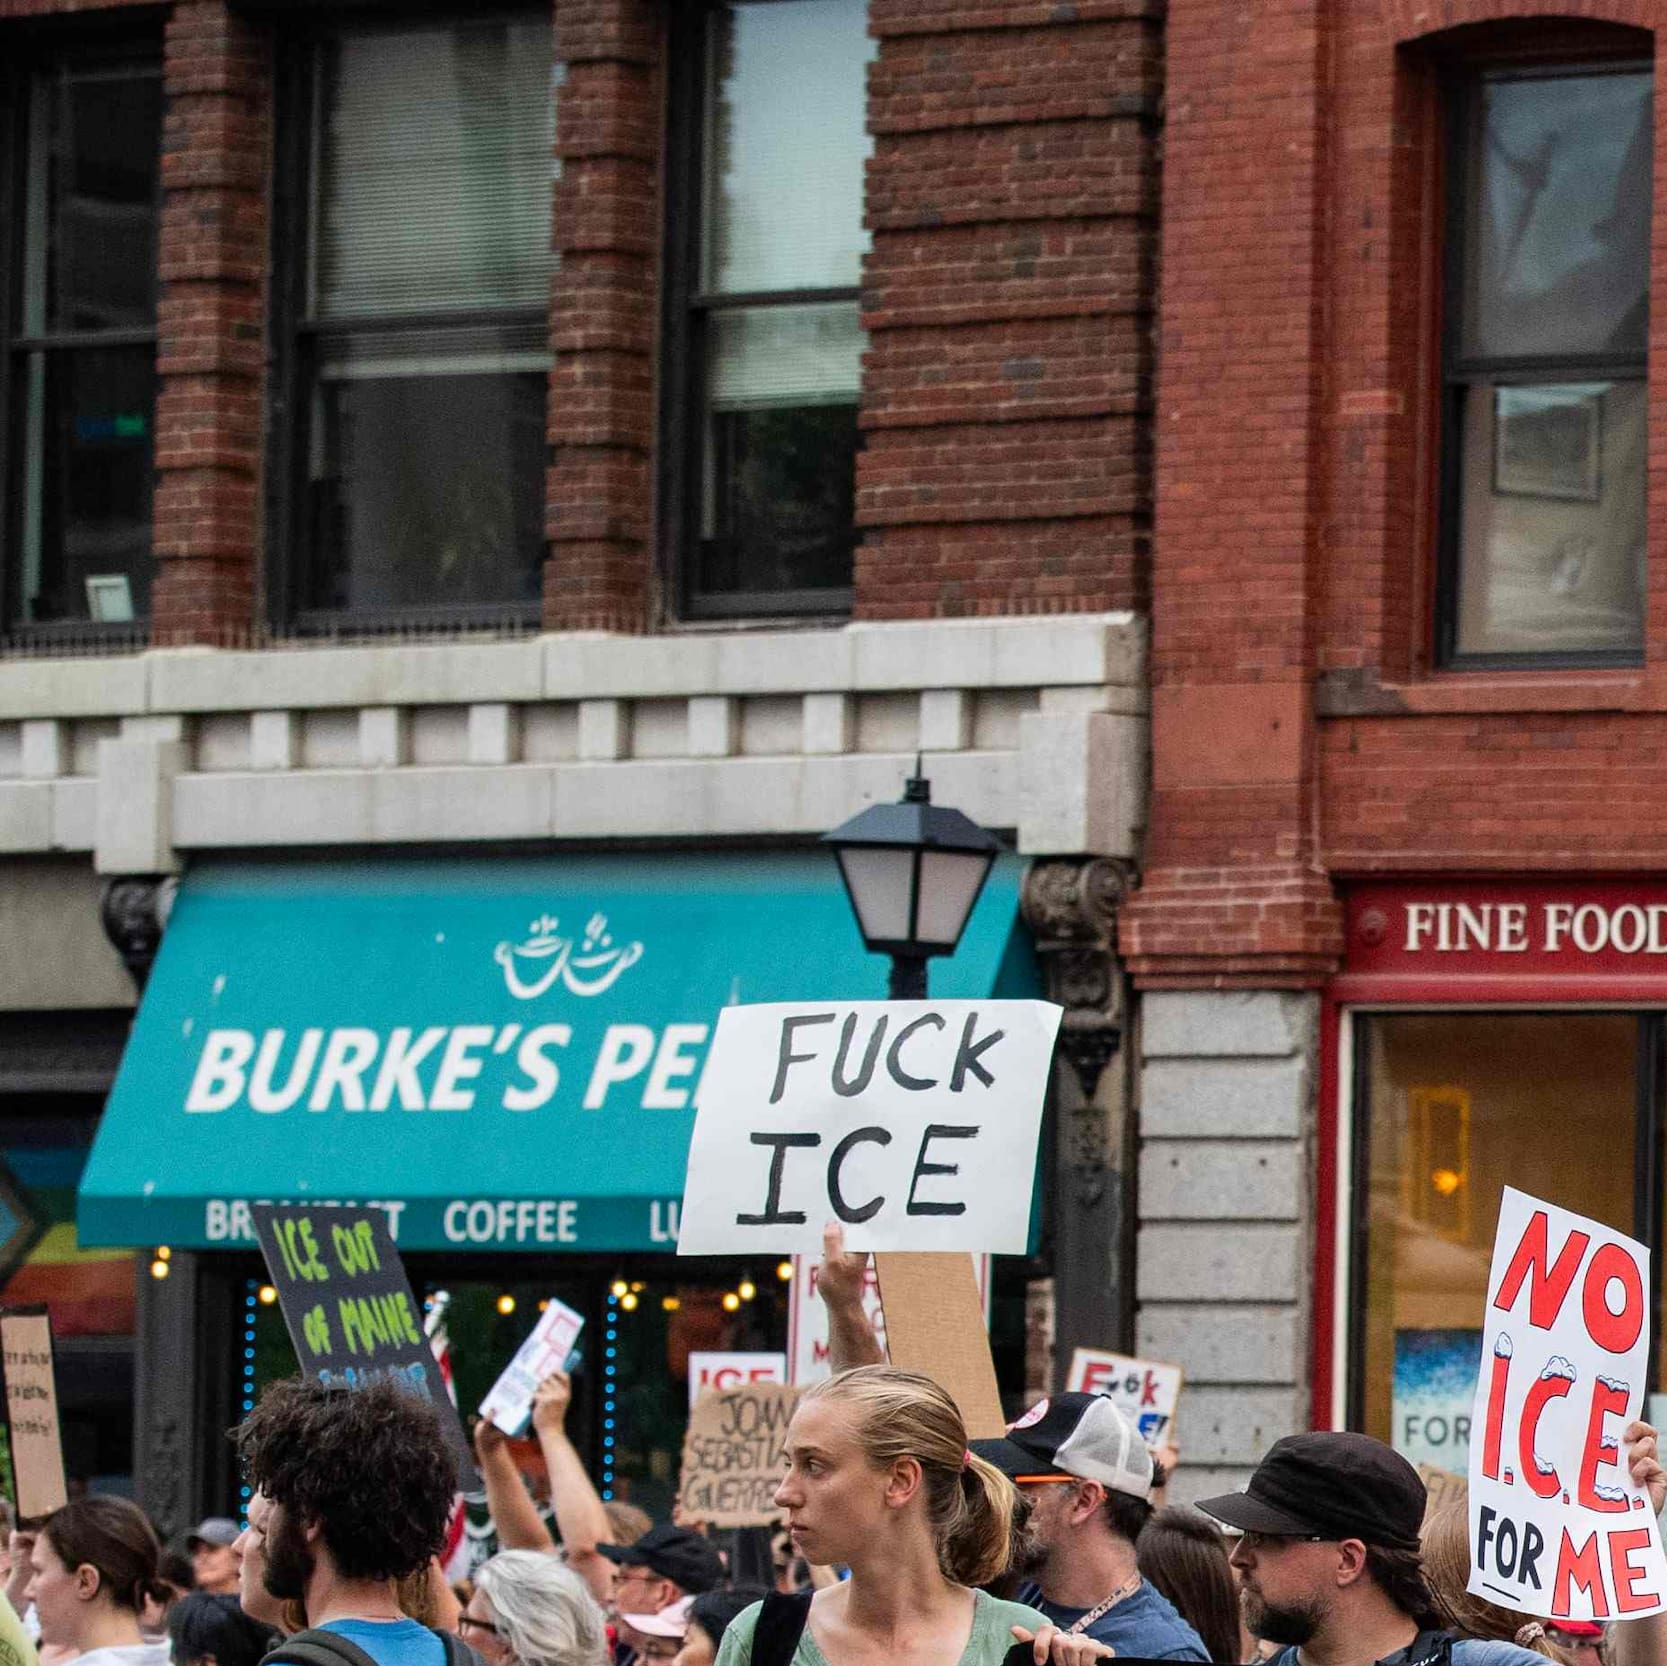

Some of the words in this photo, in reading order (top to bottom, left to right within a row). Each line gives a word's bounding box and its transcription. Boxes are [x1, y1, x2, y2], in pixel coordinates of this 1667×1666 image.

[1403, 902, 1528, 953] FINE
[184, 1024, 572, 1114] BURKE'S
[584, 1023, 709, 1112] PE
[768, 1010, 1005, 1105] FUCK
[735, 1124, 981, 1226] ICE
[273, 1217, 330, 1282] ICE
[331, 1219, 381, 1278] OUT
[443, 1200, 579, 1242] COFFEE
[338, 1291, 421, 1358] MAINE
[1494, 1210, 1645, 1354] NO
[1477, 1506, 1545, 1592] FOR
[1551, 1527, 1662, 1618] ME
